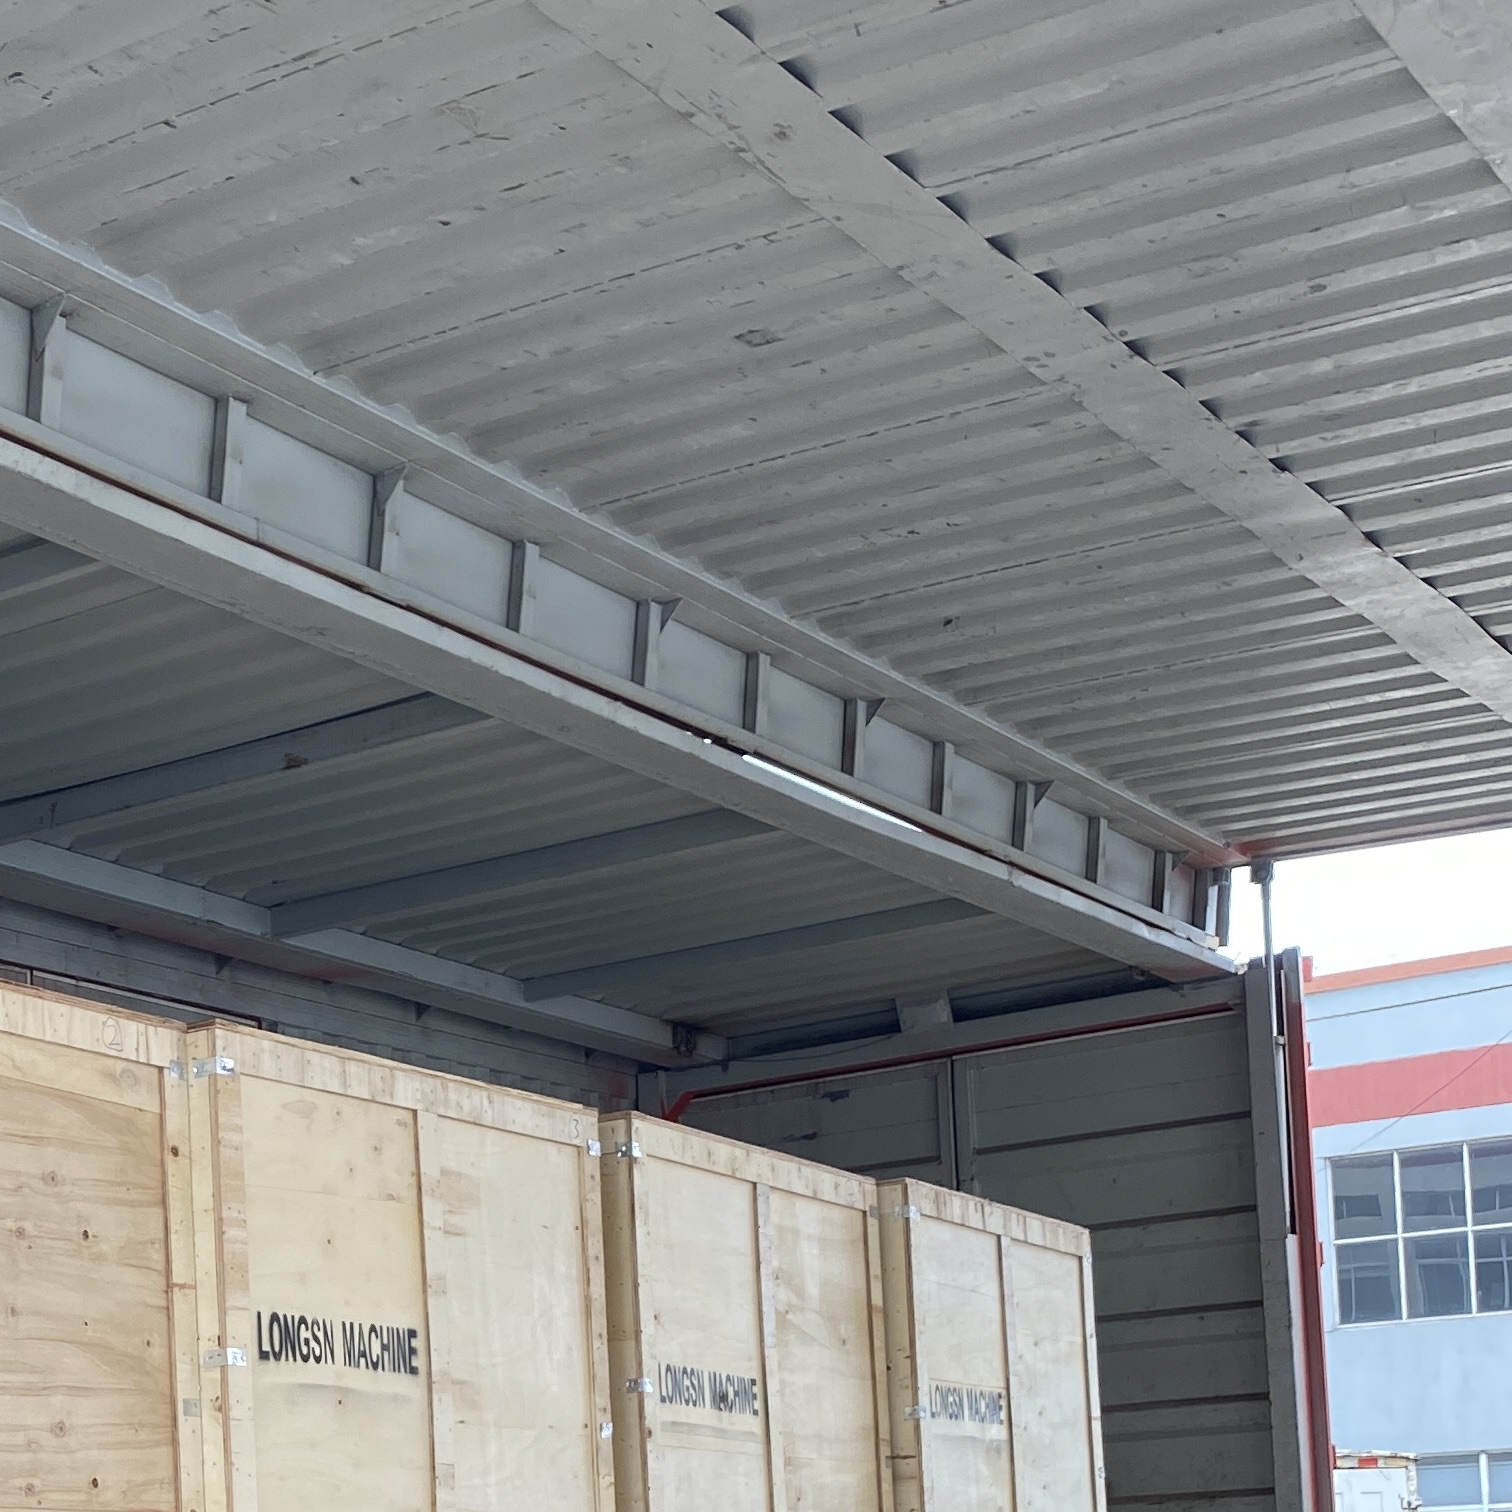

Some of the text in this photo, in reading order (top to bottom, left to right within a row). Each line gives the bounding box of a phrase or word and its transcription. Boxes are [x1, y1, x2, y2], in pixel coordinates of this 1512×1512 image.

[257, 1310, 419, 1375] LONGSN MACHINE
[658, 1362, 759, 1417] LONGSN MACHINE
[929, 1383, 1004, 1426] LONGSN MACHINE
